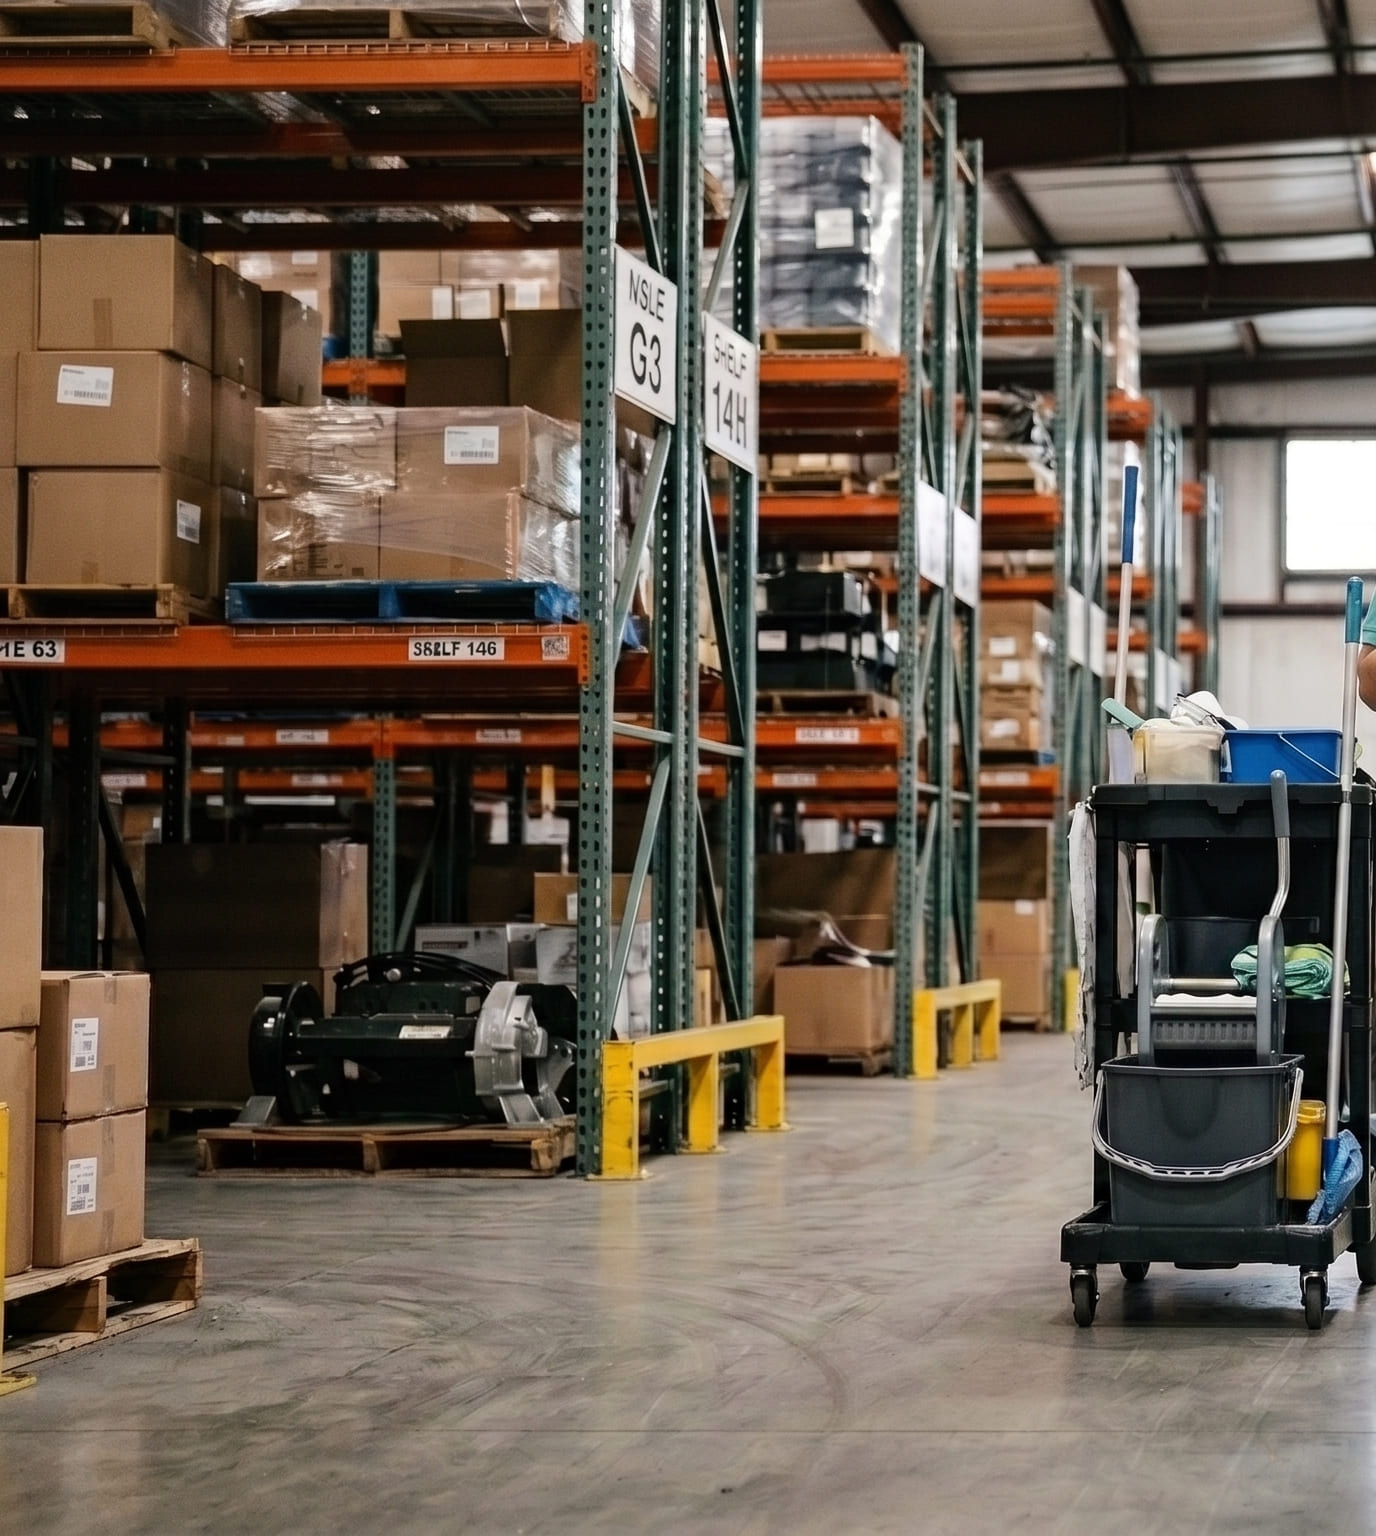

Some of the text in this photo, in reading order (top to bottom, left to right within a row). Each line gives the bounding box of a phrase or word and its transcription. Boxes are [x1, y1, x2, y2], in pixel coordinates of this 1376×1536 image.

[629, 269, 665, 323] NSLE
[630, 322, 662, 394] G3
[32, 639, 57, 658] 63
[467, 641, 497, 657] 146
